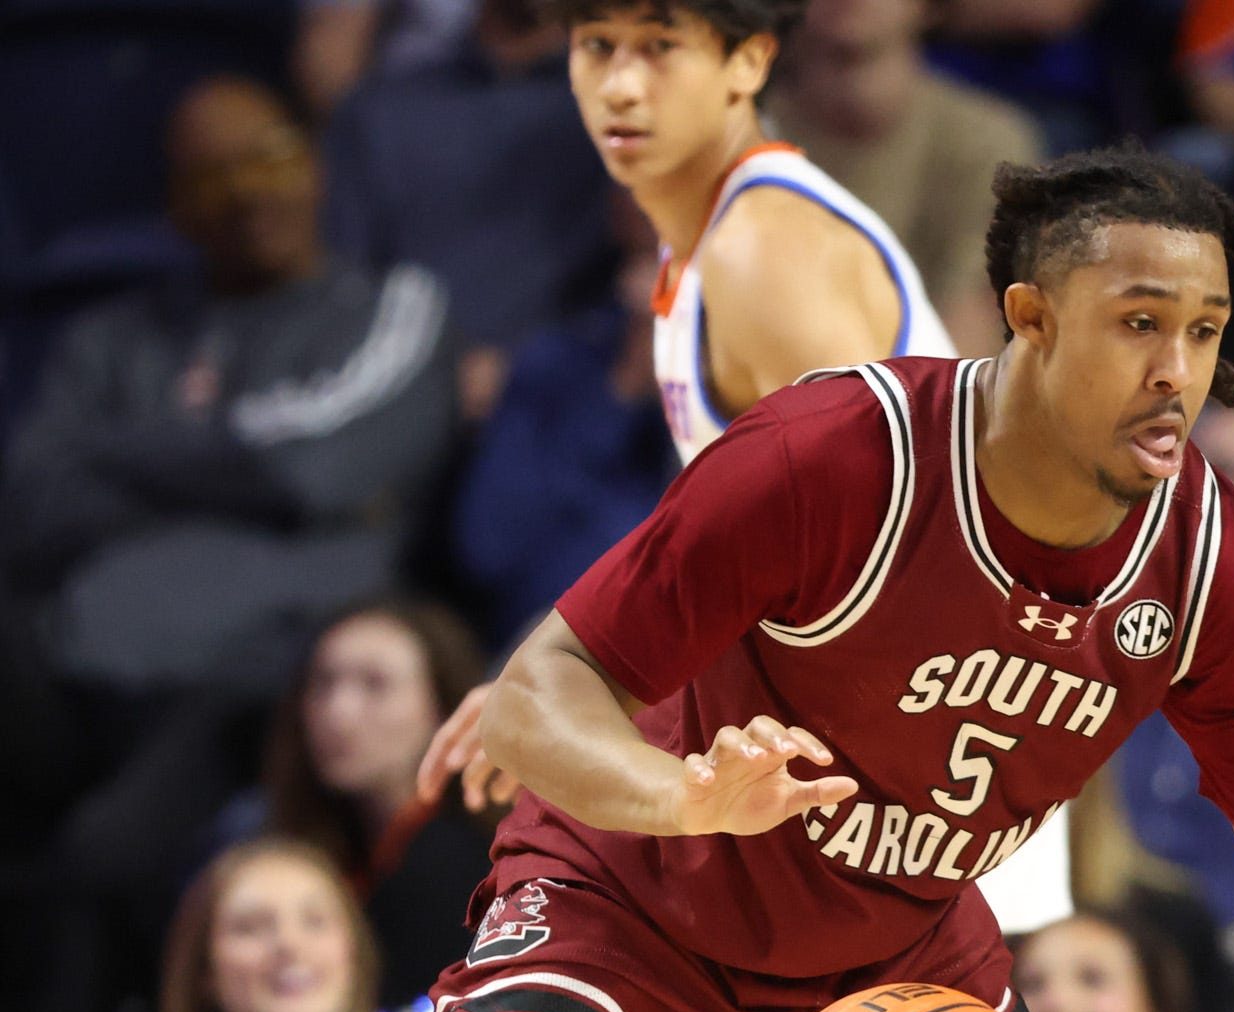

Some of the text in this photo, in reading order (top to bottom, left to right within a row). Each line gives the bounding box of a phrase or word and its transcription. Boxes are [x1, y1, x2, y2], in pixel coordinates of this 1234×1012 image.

[1118, 603, 1171, 656] SEC
[897, 648, 1118, 738] SOUTH
[930, 721, 1020, 817] 5
[800, 800, 1060, 881] CAROLIN
